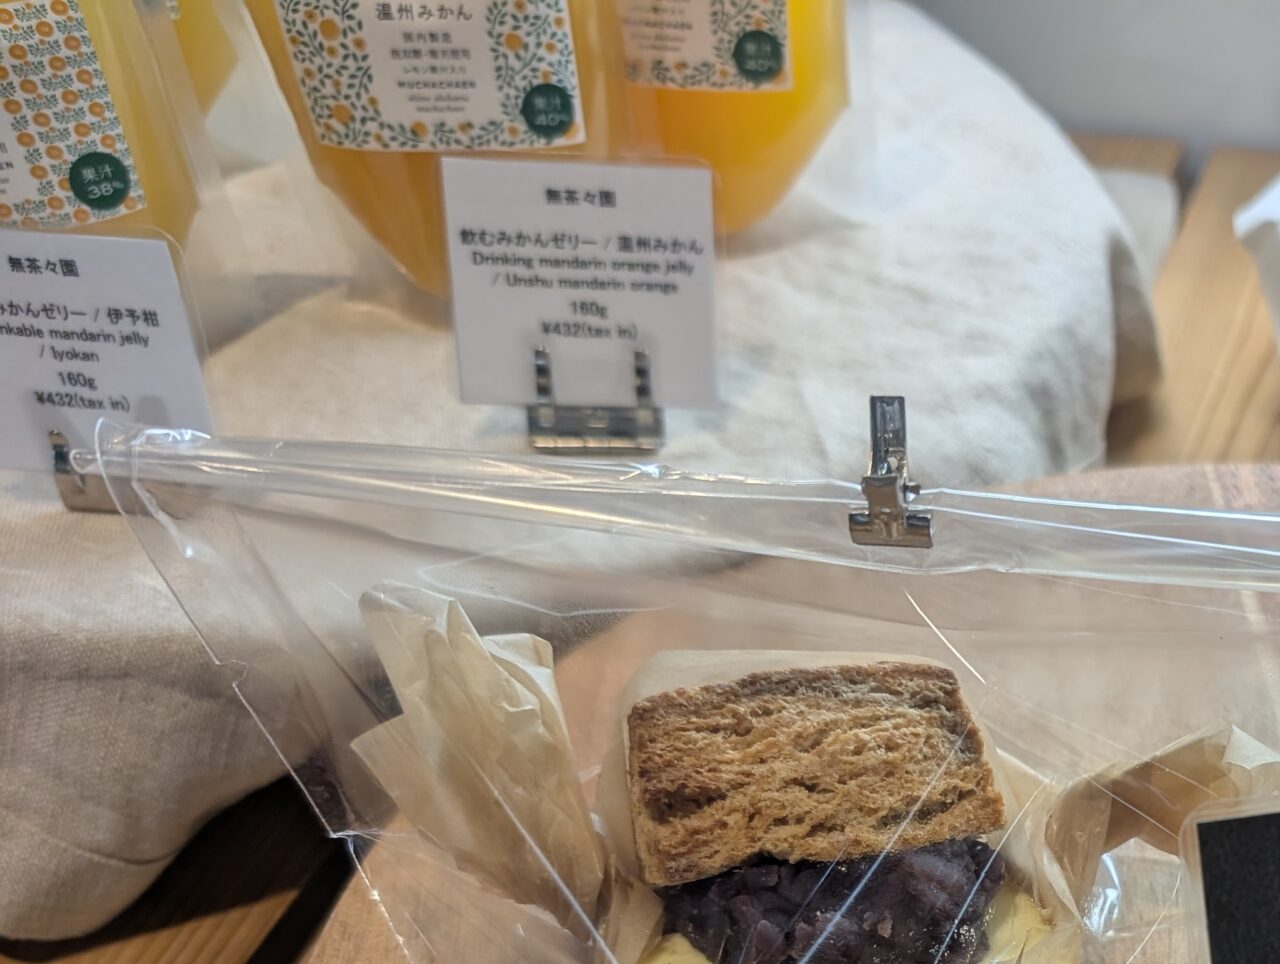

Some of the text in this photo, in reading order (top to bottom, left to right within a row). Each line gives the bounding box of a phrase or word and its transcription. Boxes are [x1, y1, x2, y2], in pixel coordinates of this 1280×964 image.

[376, 3, 473, 21] 温州みかん
[82, 164, 113, 183] 果汁
[546, 188, 617, 208] 無茶々園
[459, 228, 598, 250] 飲むみかんゼリー
[616, 234, 705, 255] 温州みかん
[8, 255, 80, 278] 無茶々園
[472, 251, 695, 277] Drinking mandarin orange jelly
[505, 274, 554, 289] Unshu
[558, 277, 626, 292] mandarin
[630, 280, 680, 295] orange
[106, 307, 160, 328] 伊予柑
[48, 328, 117, 344] mandarin
[119, 331, 150, 348] jelly
[58, 371, 98, 391] 160g
[109, 396, 131, 412] in)
